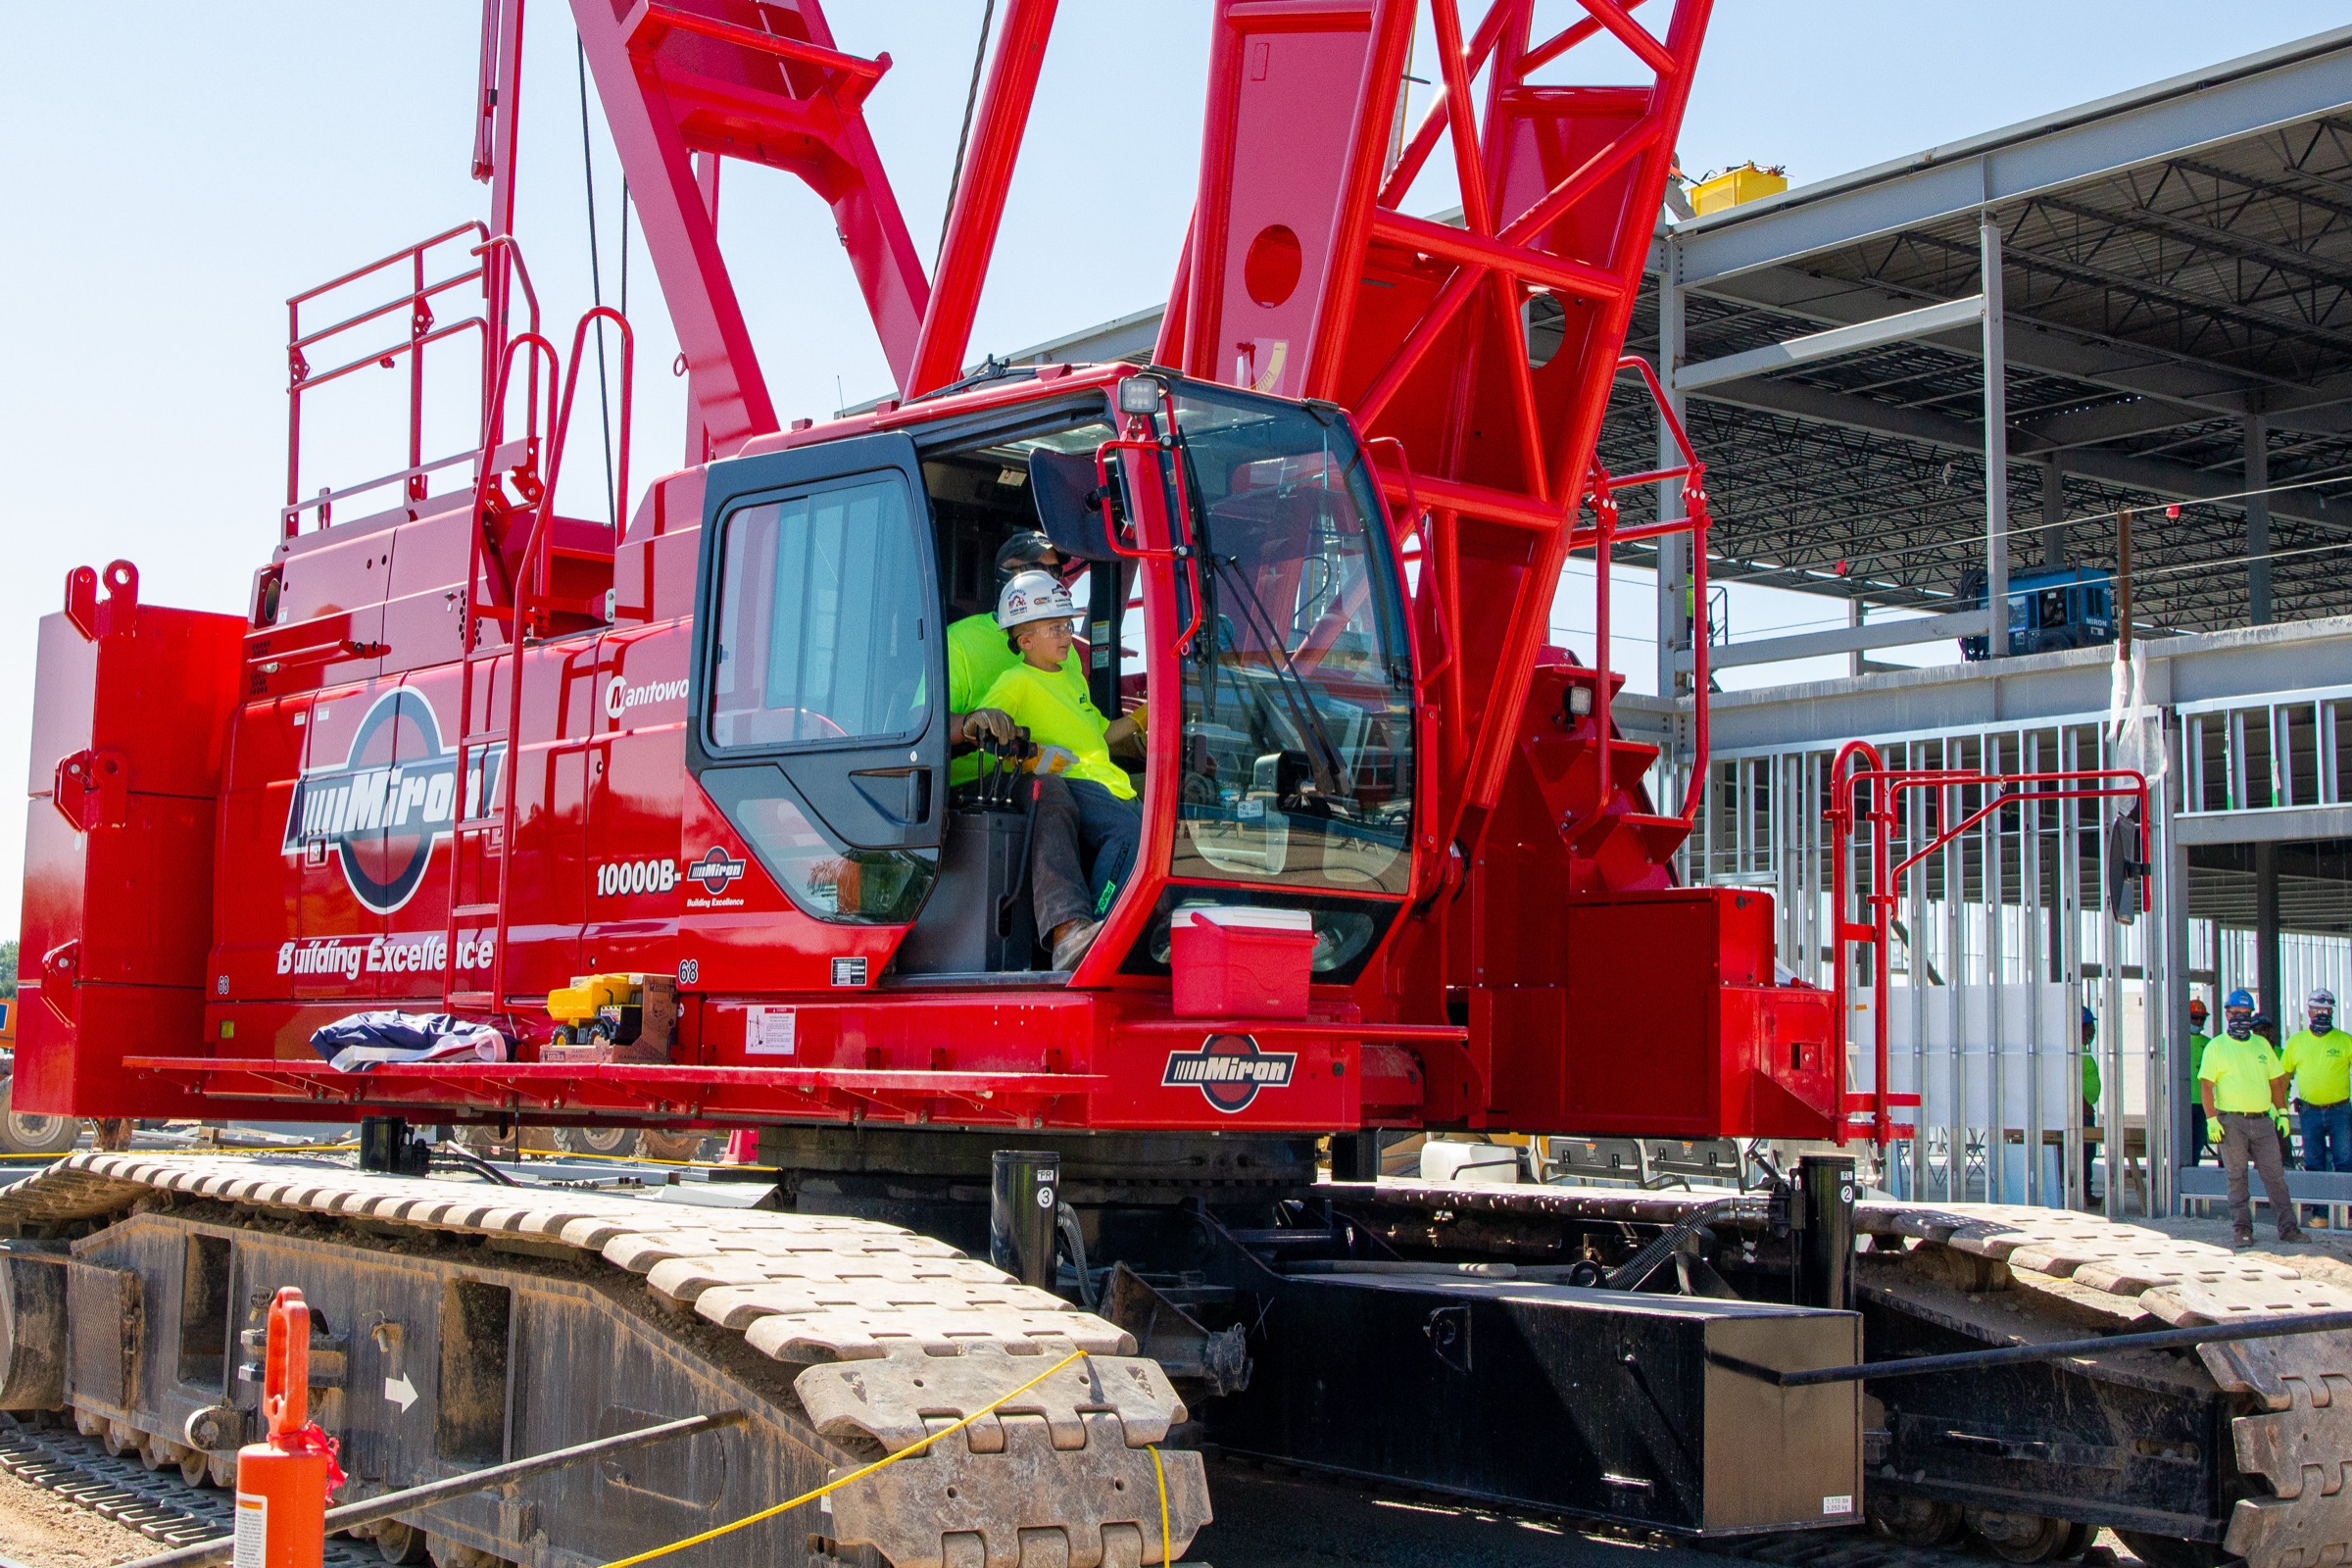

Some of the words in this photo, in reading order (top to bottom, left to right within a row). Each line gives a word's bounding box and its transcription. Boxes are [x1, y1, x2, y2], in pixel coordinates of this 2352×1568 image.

[2086, 617, 2107, 627] MIRON
[606, 675, 689, 719] Manitowo
[342, 766, 481, 833] Miron
[705, 863, 742, 878] Miron
[687, 898, 710, 908] Building
[711, 897, 744, 907] Excellence
[276, 936, 362, 980] Building
[678, 958, 699, 984] 68
[218, 975, 229, 995] 68
[1203, 1056, 1287, 1081] Miron
[1041, 1189, 1050, 1204] 3
[1843, 1187, 1850, 1200] 2
